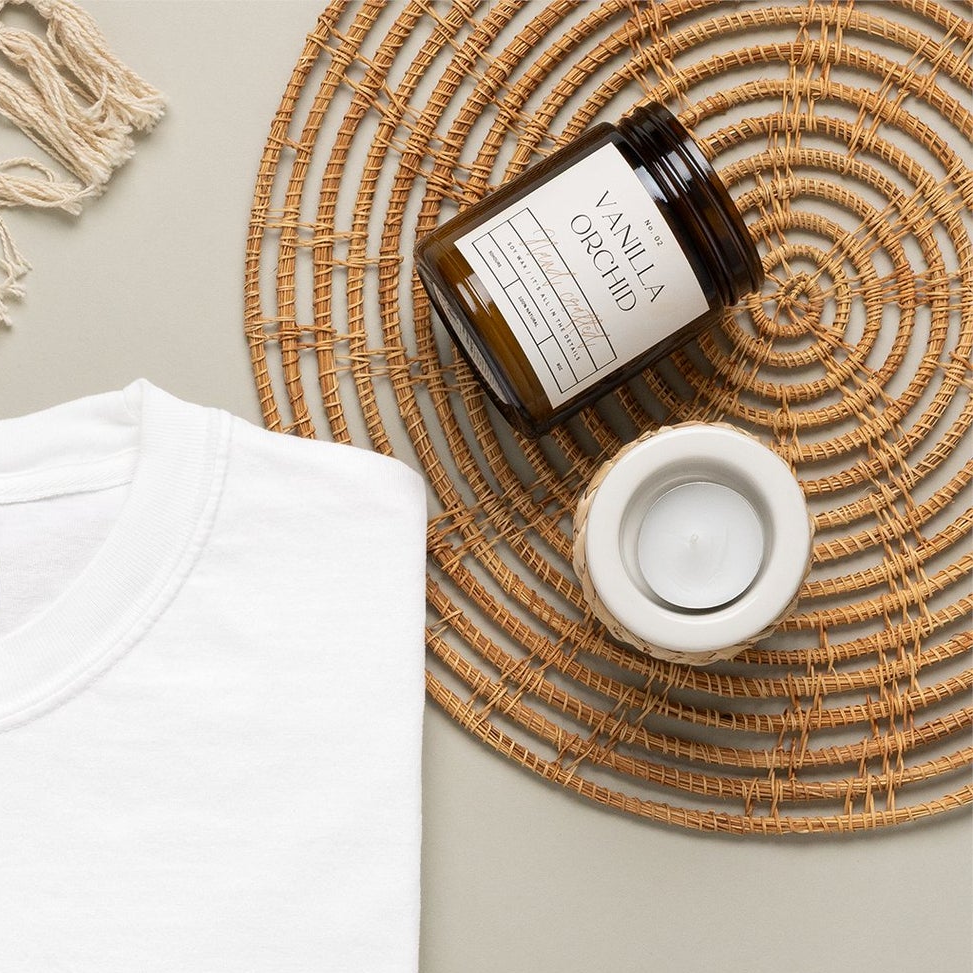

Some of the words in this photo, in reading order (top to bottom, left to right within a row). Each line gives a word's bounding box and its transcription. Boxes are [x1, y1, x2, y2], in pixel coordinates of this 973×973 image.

[571, 215, 637, 311] ORCHID
[596, 191, 665, 303] VANILLA
[644, 218, 656, 235] No.
[654, 236, 663, 246] 02
[507, 242, 517, 253] SOY
[517, 256, 527, 268] WAX
[531, 277, 541, 290] IT'S
[540, 293, 550, 307] ALL
[556, 319, 565, 332] THE
[564, 334, 581, 361] DETAILS
[526, 308, 538, 327] NATURAL
